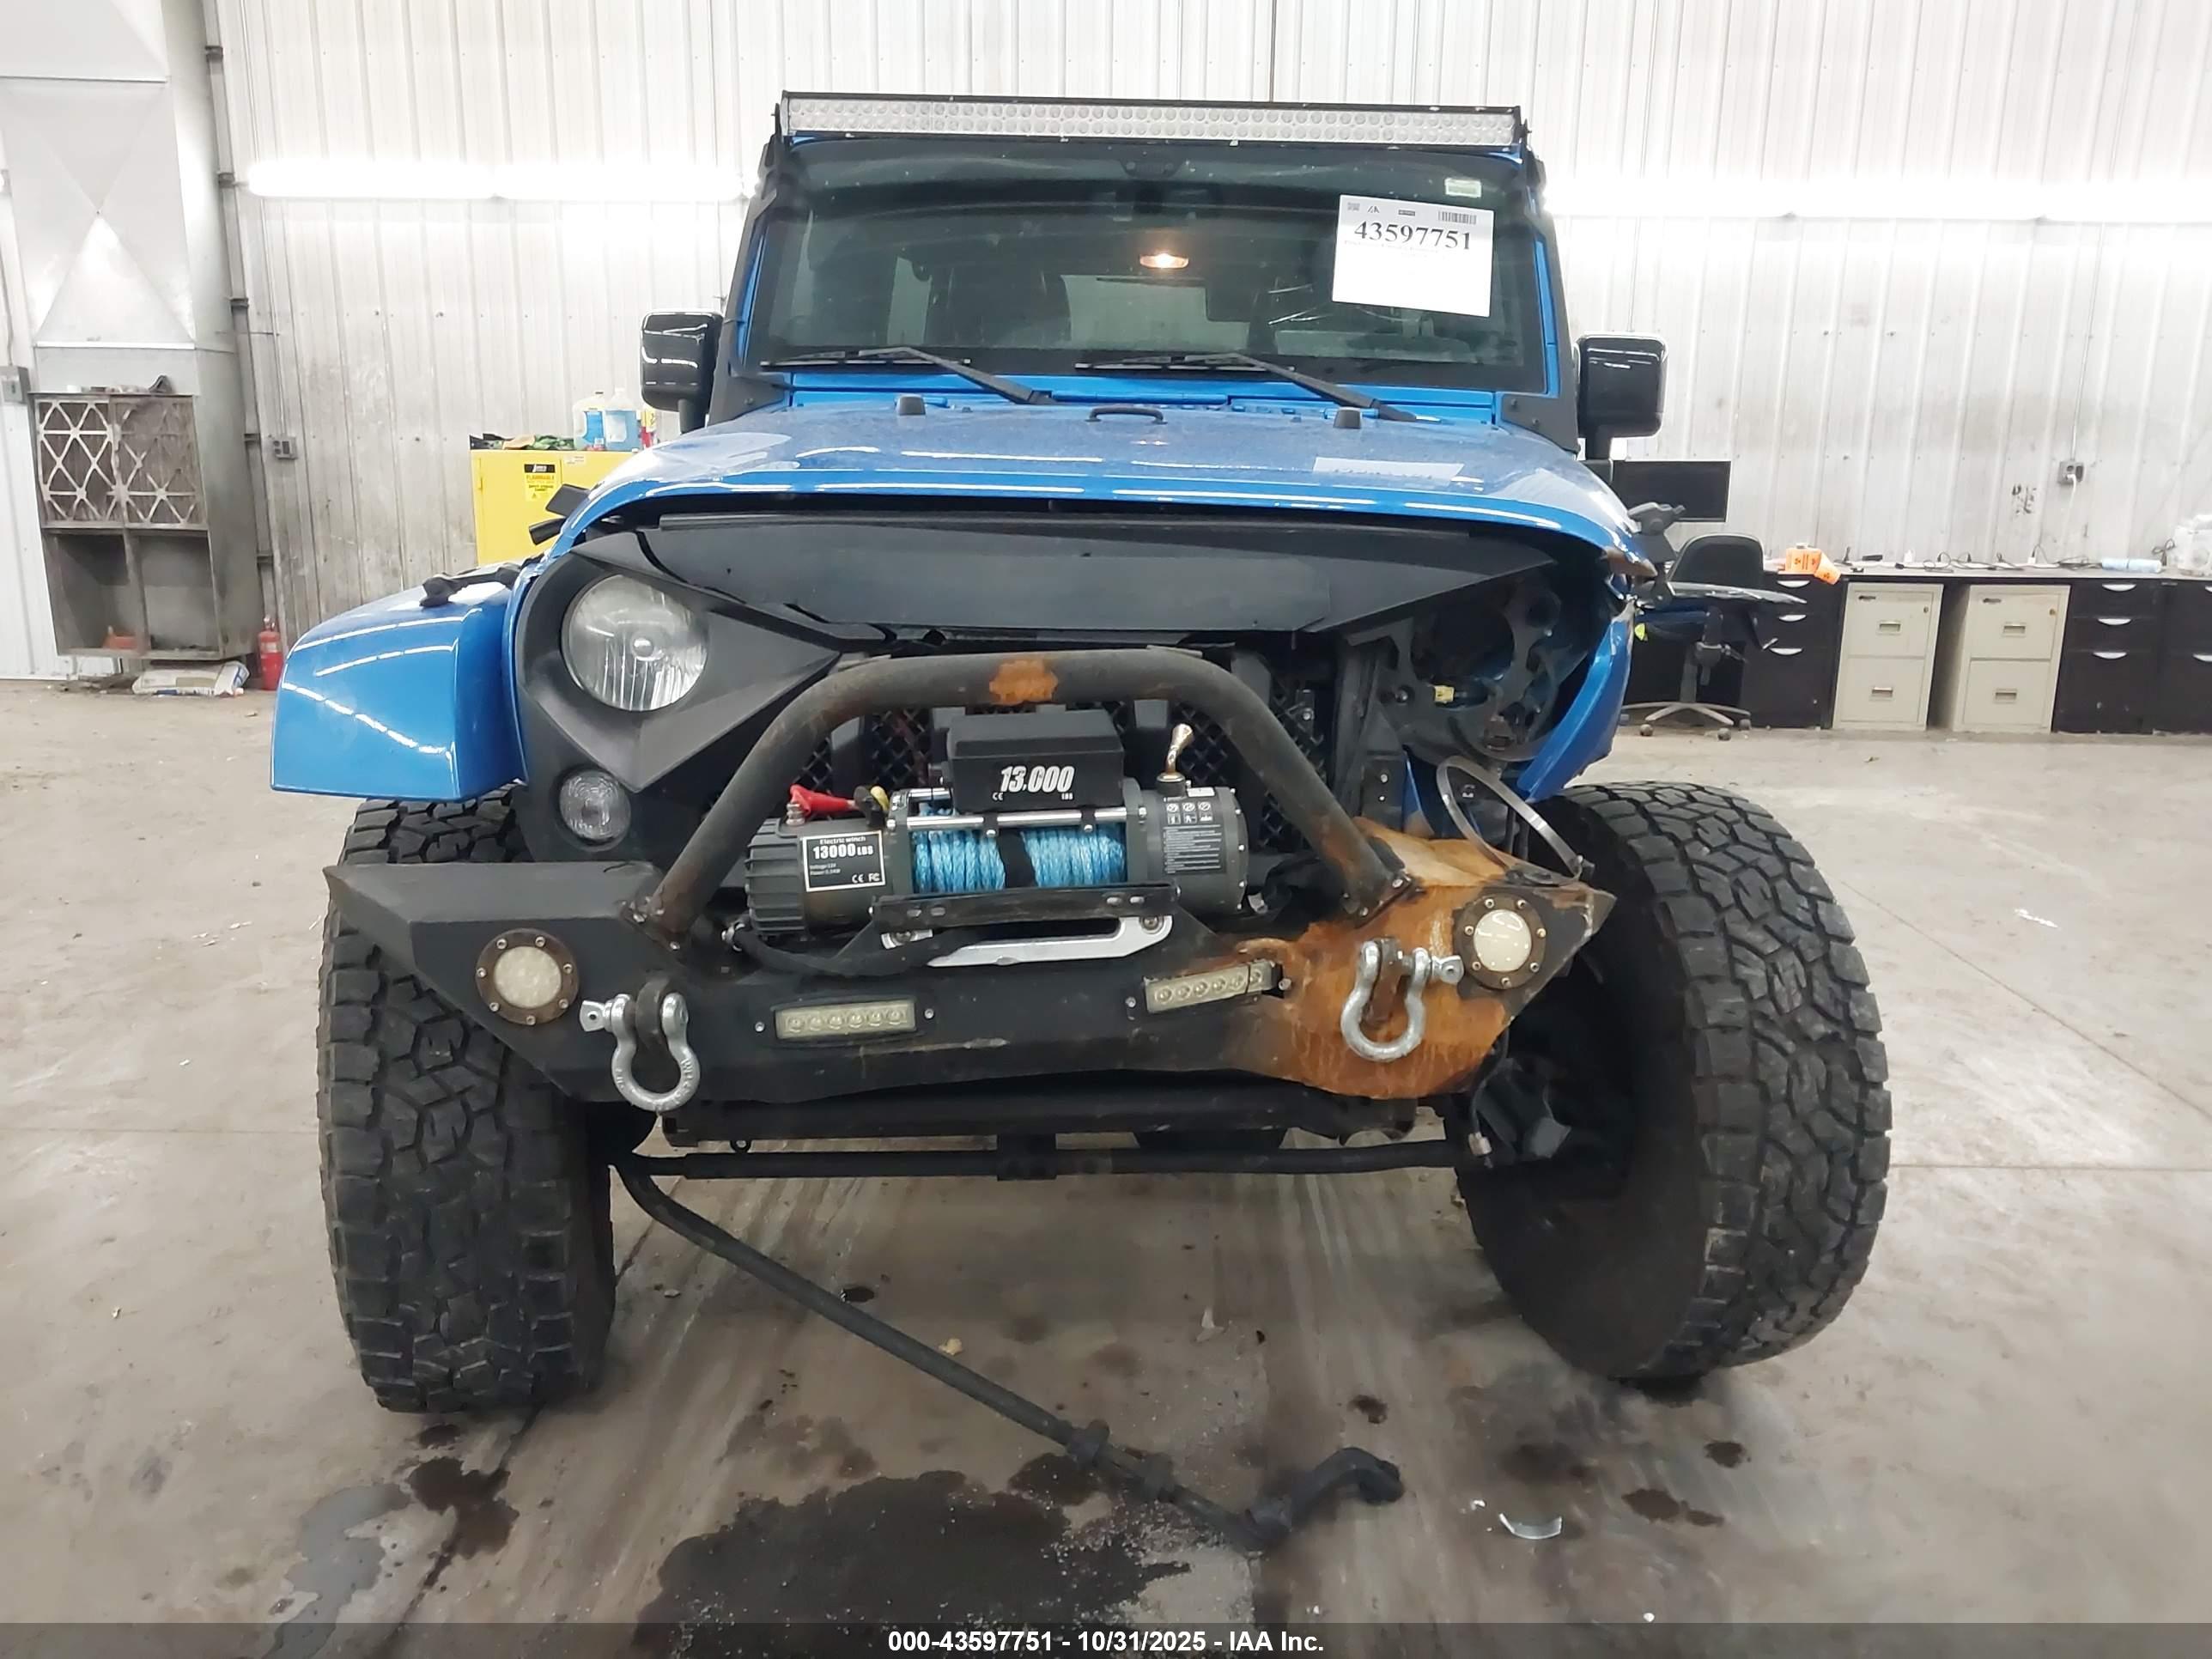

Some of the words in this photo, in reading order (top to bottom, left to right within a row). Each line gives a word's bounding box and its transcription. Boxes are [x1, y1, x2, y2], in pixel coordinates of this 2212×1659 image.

[1354, 221, 1471, 251] 43597751
[1000, 765, 1075, 793] 13,000
[812, 843, 856, 860] 13000
[857, 845, 874, 855] LBS
